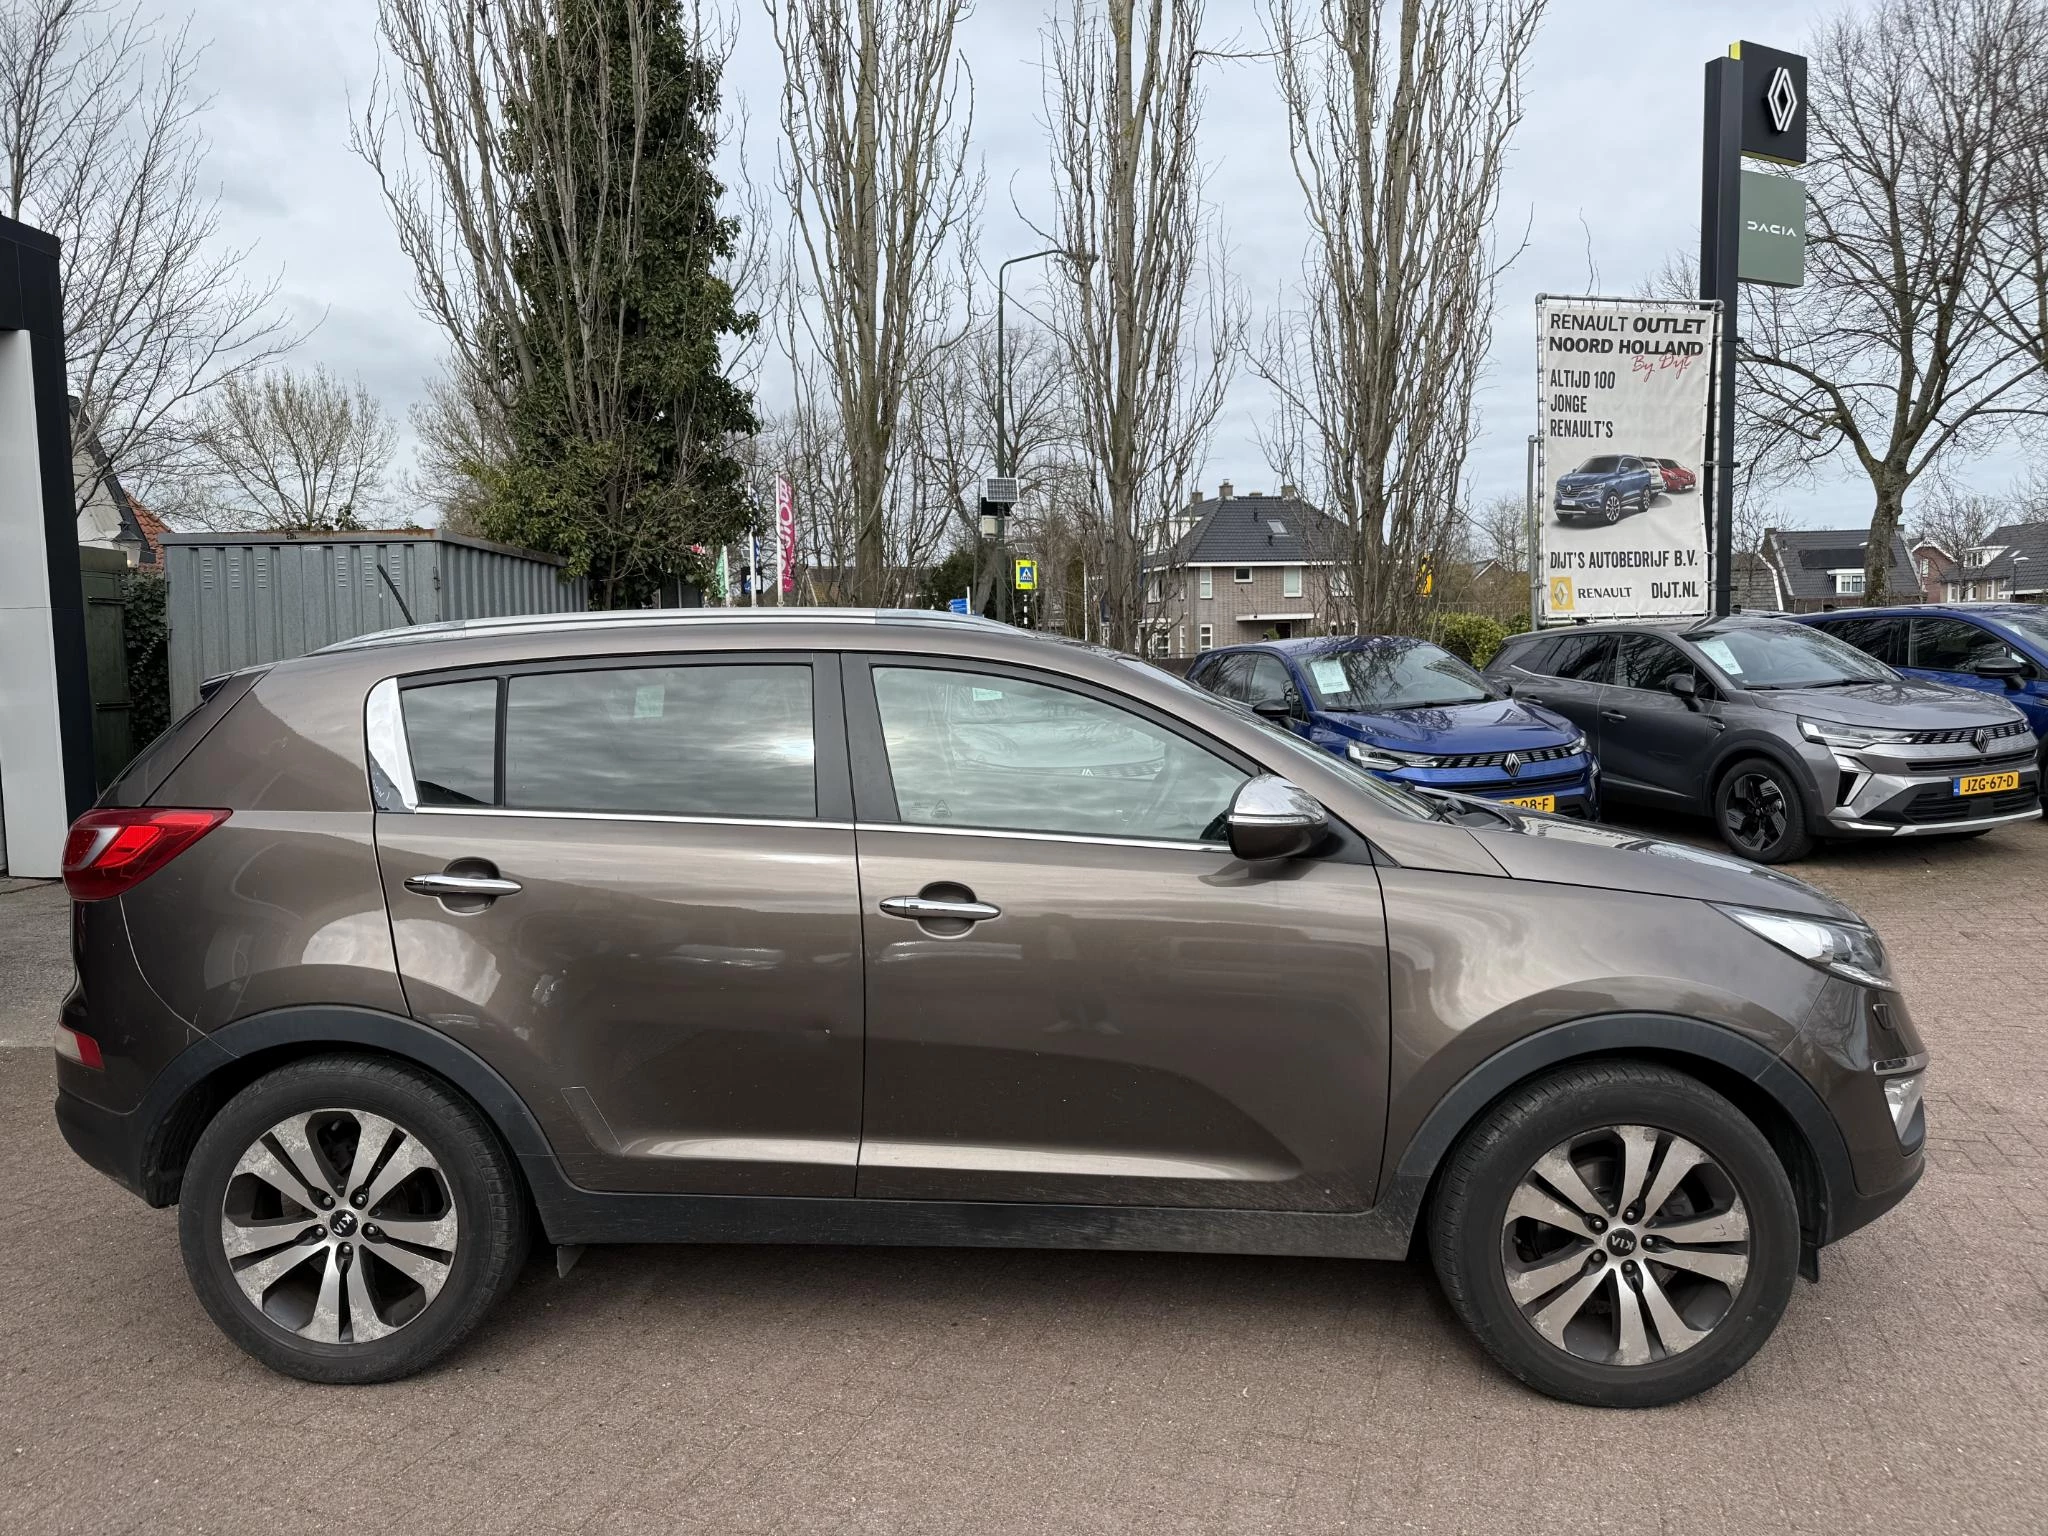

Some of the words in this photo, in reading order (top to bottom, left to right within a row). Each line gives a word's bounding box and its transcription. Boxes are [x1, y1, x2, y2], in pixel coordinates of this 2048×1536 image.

[1747, 221, 1797, 237] DACIA
[1550, 313, 1628, 331] RENAULT
[1633, 317, 1706, 334] OUTLET
[1550, 336, 1613, 353] NOORD
[1619, 340, 1704, 356] HOLLAND
[1632, 354, 1655, 382] By
[1550, 369, 1590, 388] ALTIJD
[1594, 371, 1616, 389] 100
[1550, 394, 1587, 413] JONGE
[1550, 419, 1613, 438] RENAULT'S
[1550, 551, 1585, 569] DIJT'S
[1589, 551, 1670, 568] AUTOBEDRIJF
[1674, 550, 1698, 567] B.V.
[1578, 587, 1632, 599] RENAULT
[1651, 581, 1699, 598] DIJT.NL
[1965, 775, 2014, 792] JZG-67-D
[334, 1213, 353, 1233] KIA
[1612, 1235, 1634, 1250] KIA
